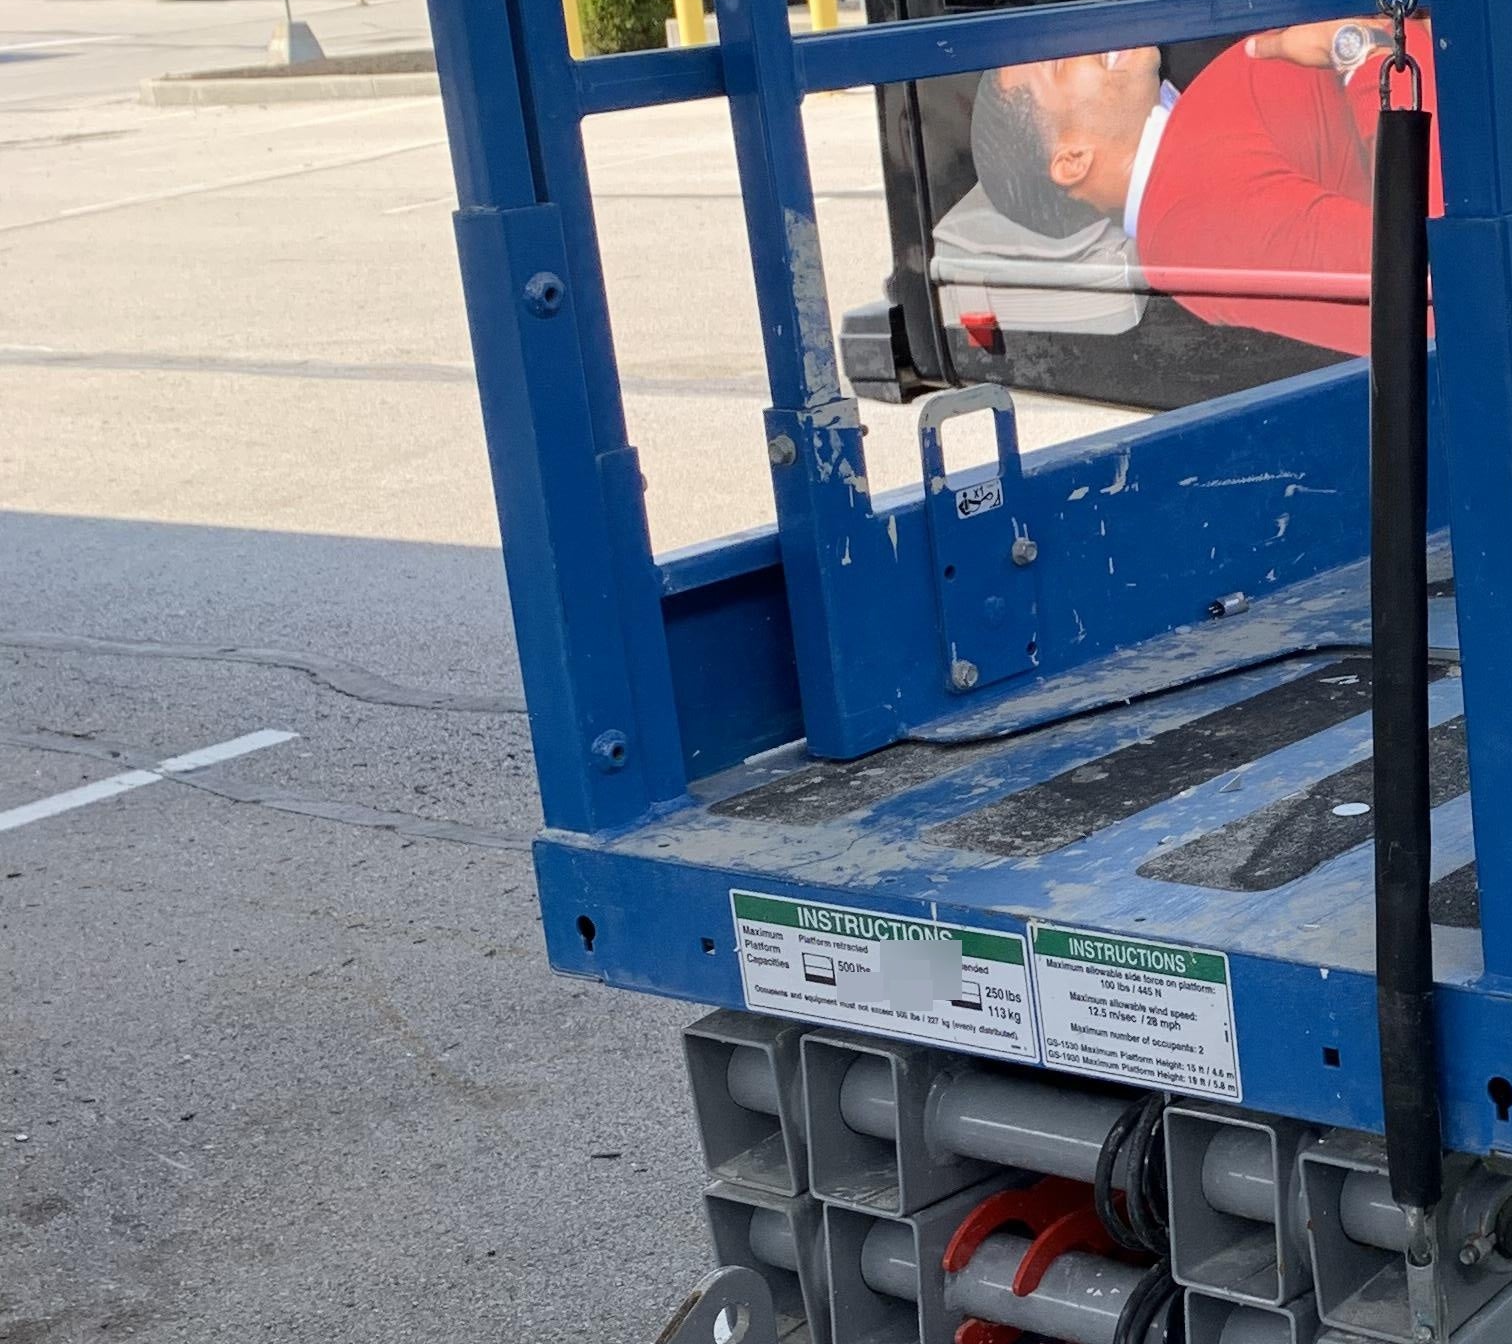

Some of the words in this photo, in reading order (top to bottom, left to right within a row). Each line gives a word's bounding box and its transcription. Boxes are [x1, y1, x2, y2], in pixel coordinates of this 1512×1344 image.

[743, 925, 784, 940] Maximum
[744, 939, 781, 954] Platform
[798, 934, 832, 948] Platform
[832, 939, 868, 954] retracted
[746, 953, 790, 969] Capacities
[1069, 937, 1186, 973] INSTRUCTIONS
[838, 961, 855, 973] 500
[1046, 958, 1084, 973] Maximum
[1085, 964, 1122, 980] allowable
[1124, 971, 1142, 982] side
[1143, 975, 1164, 986] force
[1166, 979, 1177, 987] on
[1178, 981, 1216, 995] platform:
[985, 986, 1005, 1001] 250
[1006, 989, 1022, 1003] lbs
[1100, 979, 1115, 990] 100
[1117, 983, 1130, 993] lbs
[1138, 986, 1153, 996] 445
[1155, 988, 1162, 998] N
[988, 1006, 1007, 1019] 113
[1008, 1008, 1021, 1025] kg
[1069, 991, 1108, 1007] Maximum
[1109, 998, 1147, 1013] allowable
[1149, 1005, 1168, 1016] wind
[1170, 1009, 1198, 1022] speed:
[941, 1018, 950, 1029] kg
[1088, 1006, 1107, 1018] 12.5
[1109, 1010, 1137, 1023] m/sec
[1146, 1017, 1158, 1027] 28
[1160, 1019, 1181, 1031] mph
[1070, 1022, 1108, 1038] Maximum
[1110, 1030, 1140, 1044] number
[1142, 1035, 1151, 1045] of
[1152, 1038, 1197, 1054] occupants:
[1199, 1045, 1205, 1055] 2
[1046, 1037, 1079, 1051] GS-1530
[1080, 1043, 1118, 1058] Maximum
[1120, 1051, 1154, 1065] Platform
[1156, 1058, 1185, 1072] Height:
[1048, 1049, 1080, 1064] GS-1930
[1082, 1055, 1120, 1070] Maximum
[1121, 1062, 1155, 1077] Platform
[1157, 1070, 1186, 1083] Height:
